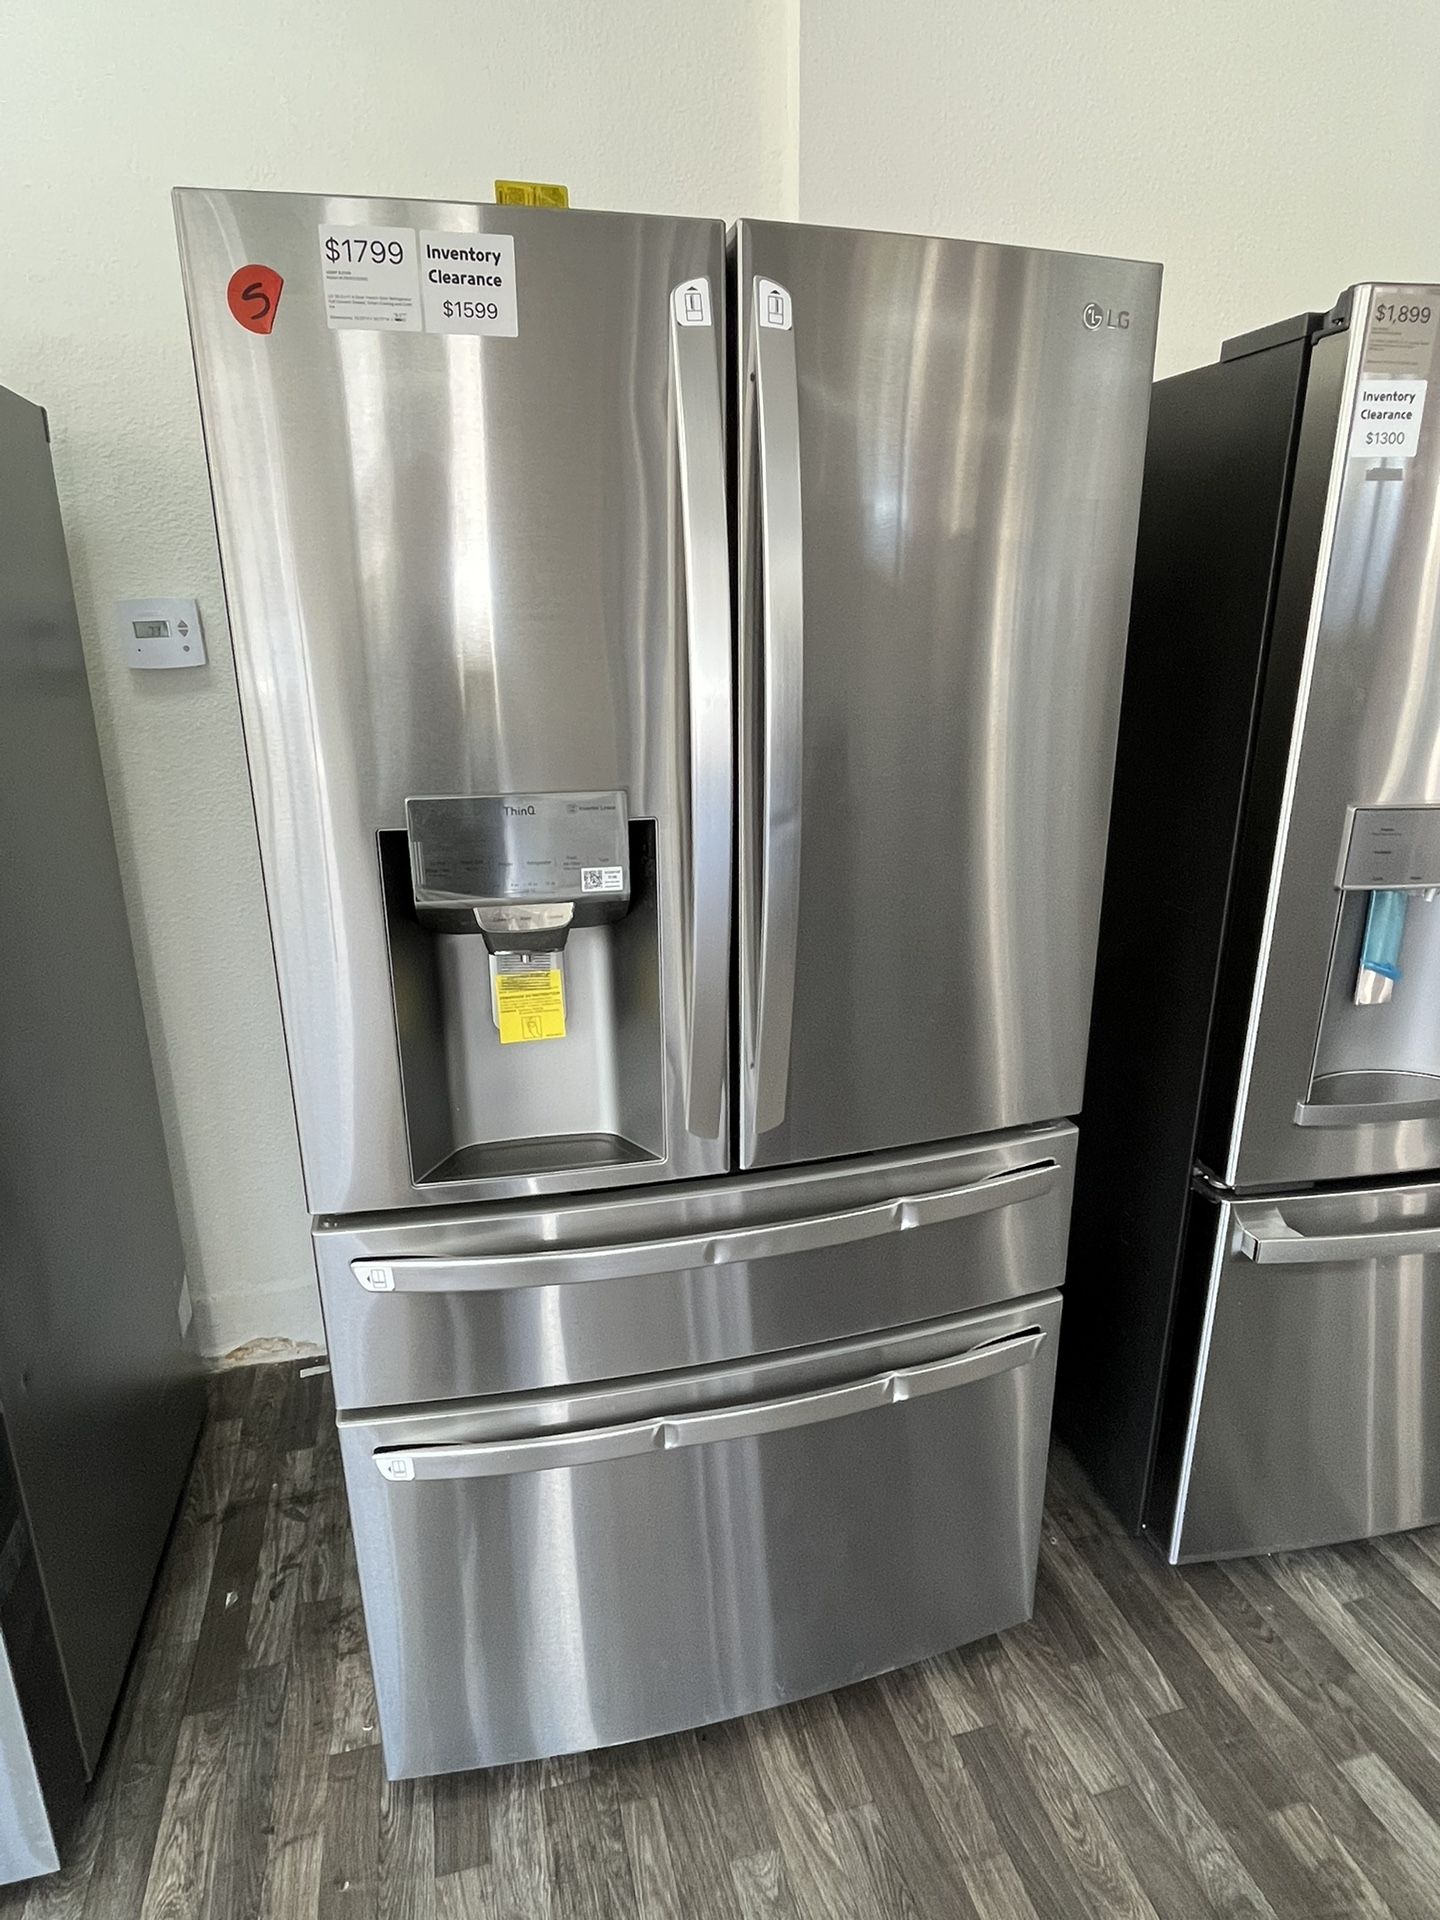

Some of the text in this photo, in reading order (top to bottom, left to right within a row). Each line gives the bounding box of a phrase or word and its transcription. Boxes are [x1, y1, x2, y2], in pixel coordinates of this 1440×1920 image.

[325, 236, 404, 265] $1799
[426, 244, 501, 266] Inventory
[428, 268, 502, 287] Clearance
[443, 299, 498, 320] $1599
[1375, 303, 1432, 325] $1,899
[1362, 391, 1416, 404] Inventory
[1360, 409, 1413, 420] Clearance
[1365, 431, 1405, 445] $1300
[504, 805, 536, 816] ThinQ
